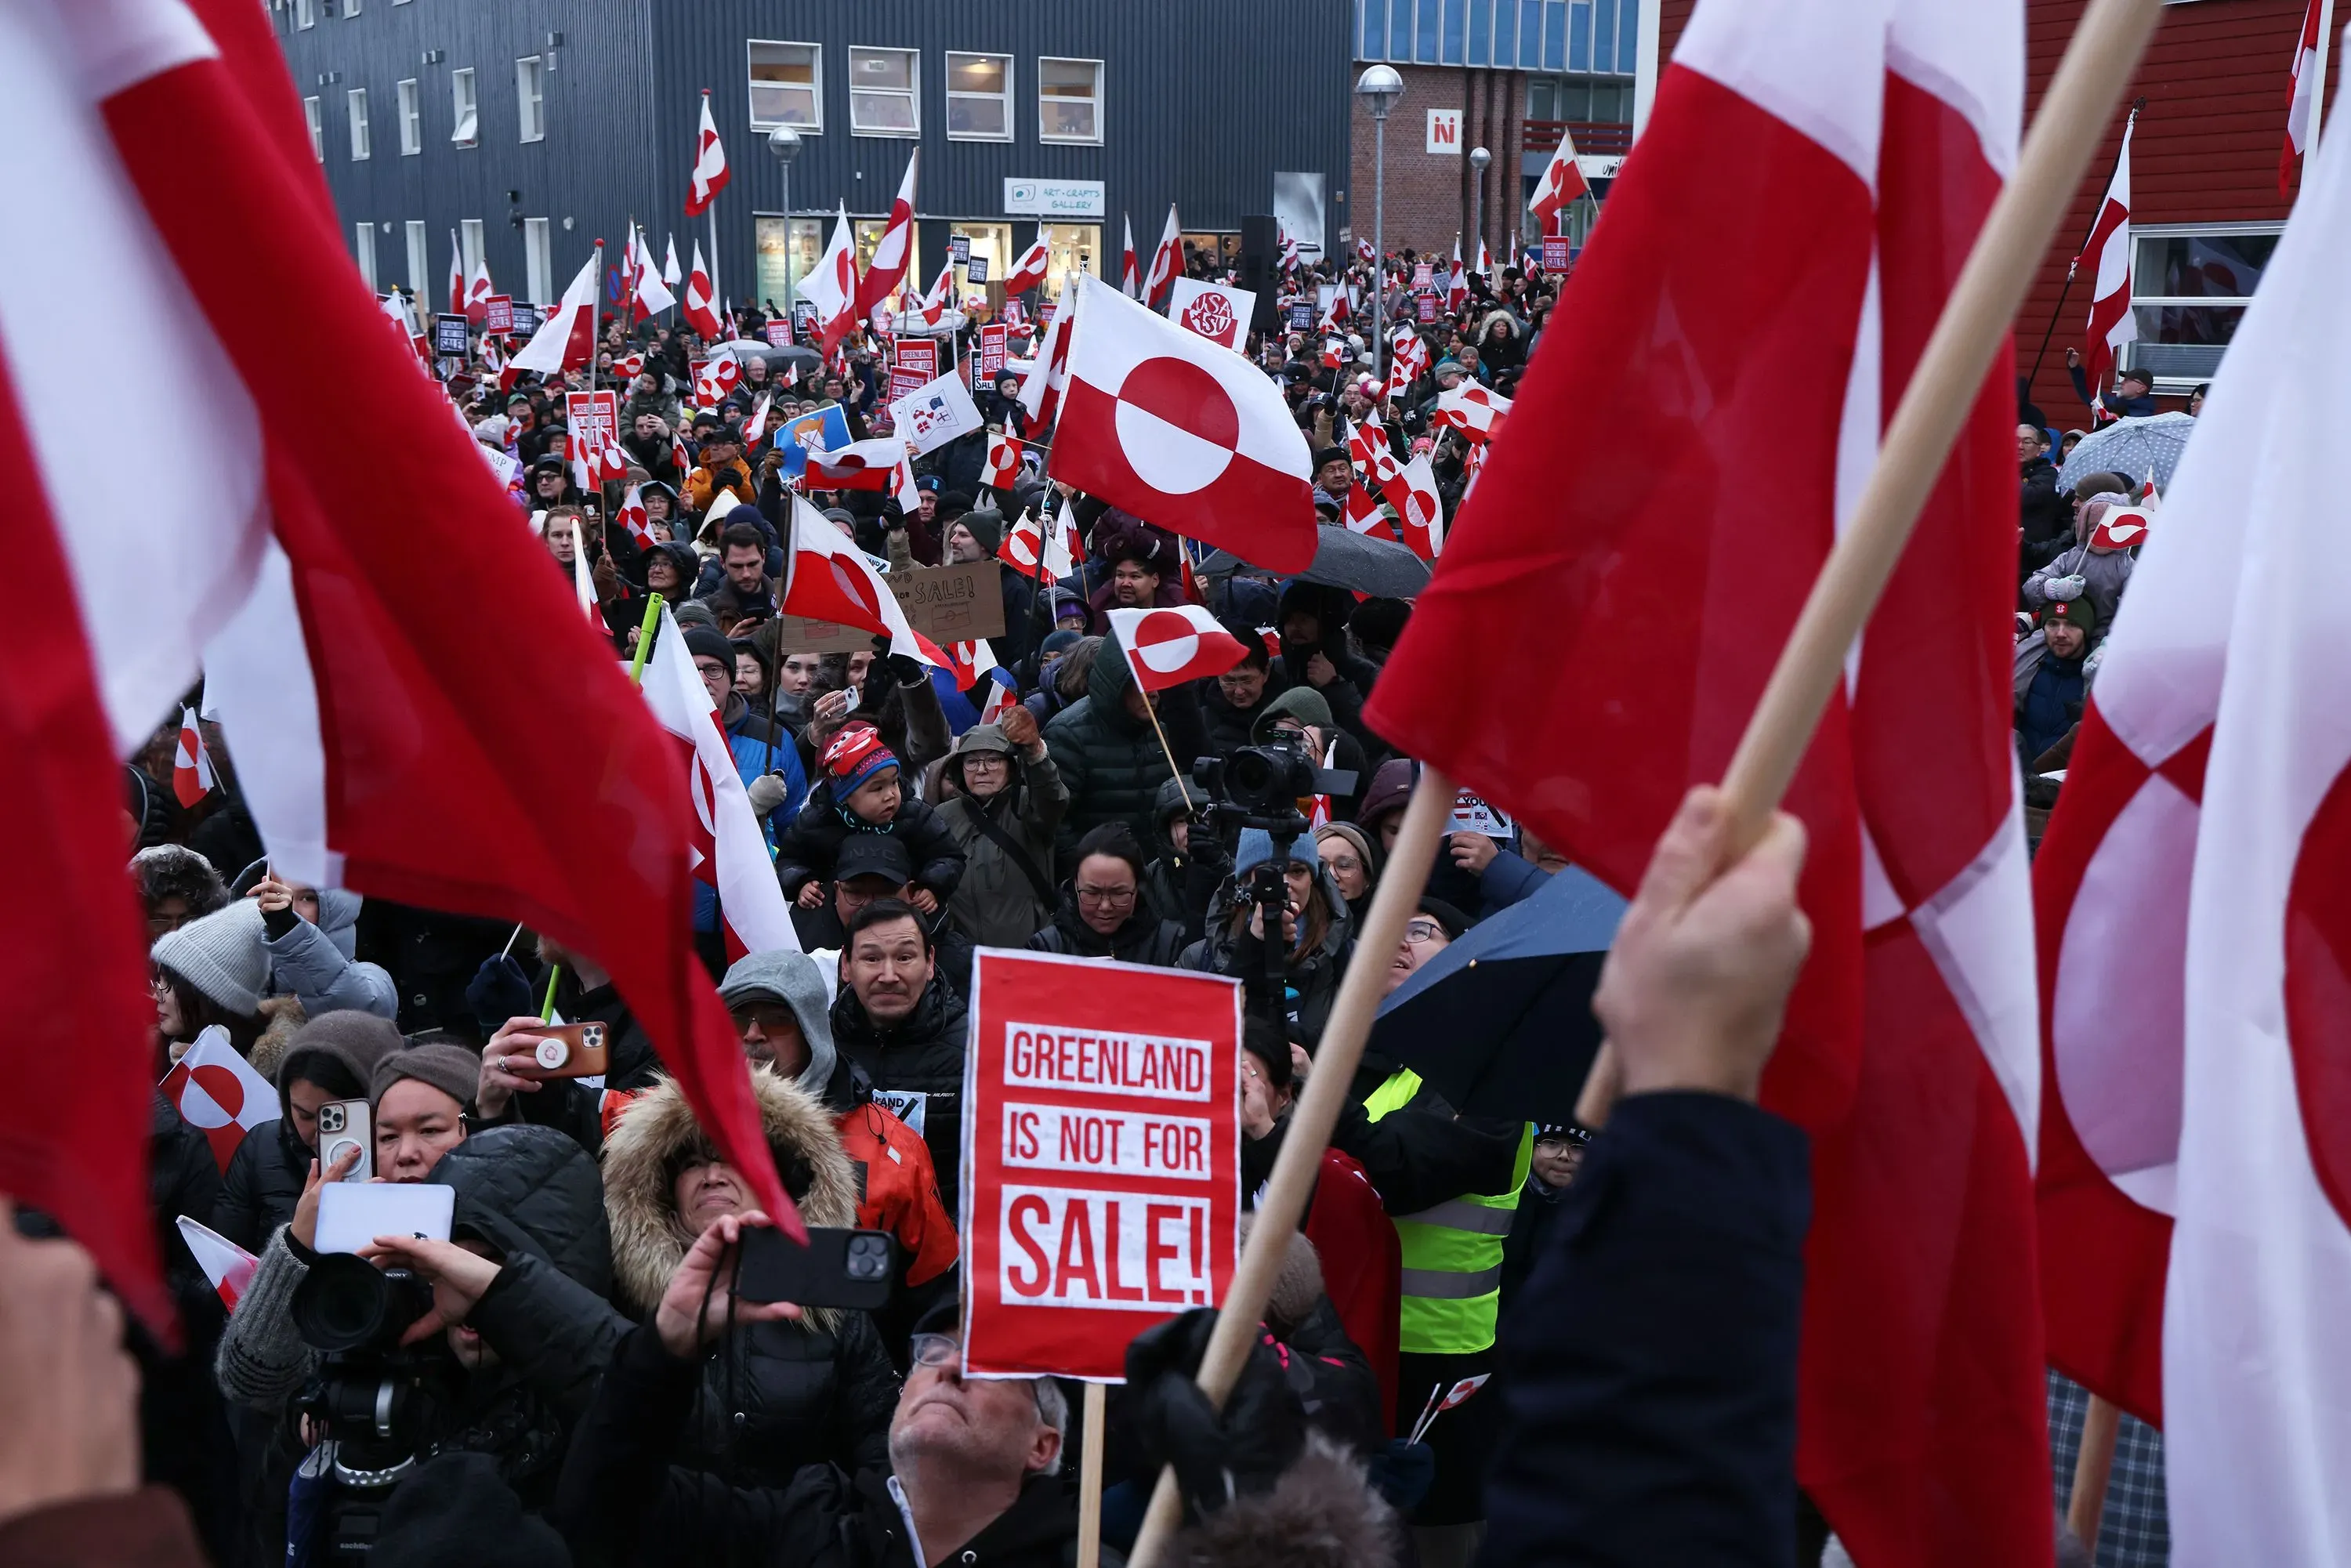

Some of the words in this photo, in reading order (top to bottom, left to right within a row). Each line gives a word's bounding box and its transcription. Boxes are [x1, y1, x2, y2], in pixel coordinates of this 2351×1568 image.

[1043, 188, 1060, 197] ART
[1066, 189, 1100, 197] CRAFTS
[1051, 200, 1092, 209] GALLERY
[1546, 258, 1566, 268] SALE!
[1195, 294, 1231, 318] USA
[490, 316, 510, 328] SALE!
[1293, 318, 1309, 327] SALE!
[441, 339, 465, 350] SALE!
[984, 357, 1002, 371] SALE!
[894, 376, 923, 386] GREENLAND
[976, 377, 994, 389] SAL
[574, 404, 610, 414] GREELAND
[915, 575, 976, 604] SALE!
[849, 847, 897, 861] NYC
[1011, 1030, 1204, 1093] GREENLAND
[1009, 1110, 1040, 1160] IS
[1060, 1115, 1125, 1166] NOT
[1143, 1122, 1204, 1172] FOR
[1007, 1193, 1205, 1305] SALE!
